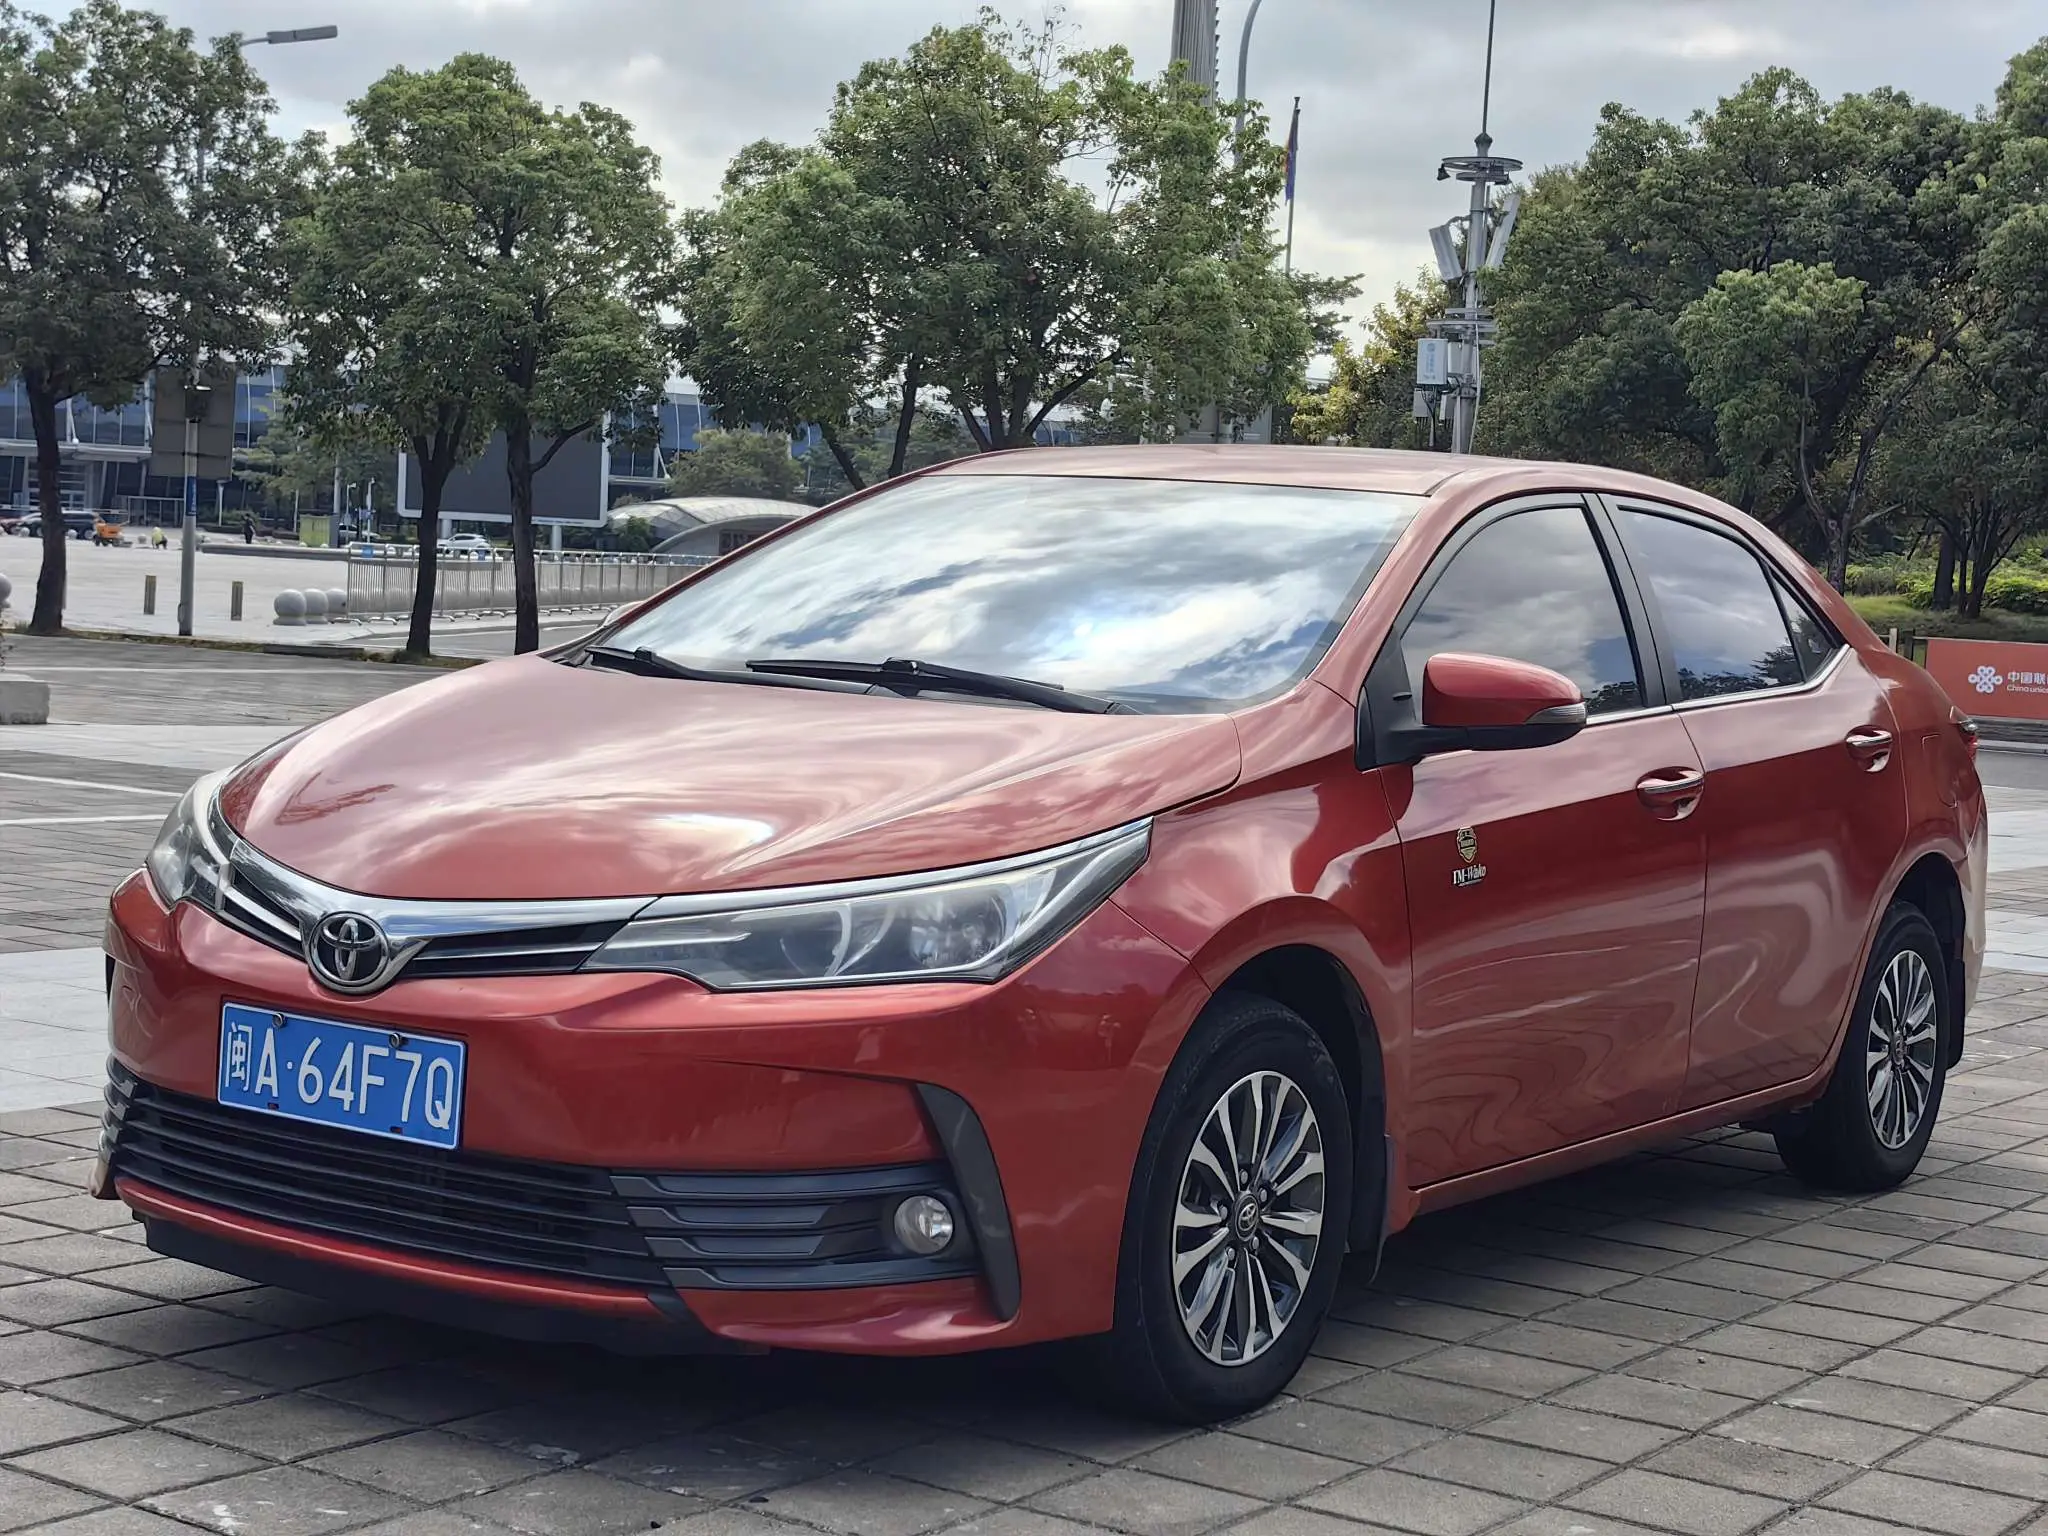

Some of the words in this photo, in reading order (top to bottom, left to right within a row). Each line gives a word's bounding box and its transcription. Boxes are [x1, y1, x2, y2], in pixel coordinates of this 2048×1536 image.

[2008, 672, 2048, 685] 中国联
[225, 1021, 454, 1130] 闽A·64F7Q
